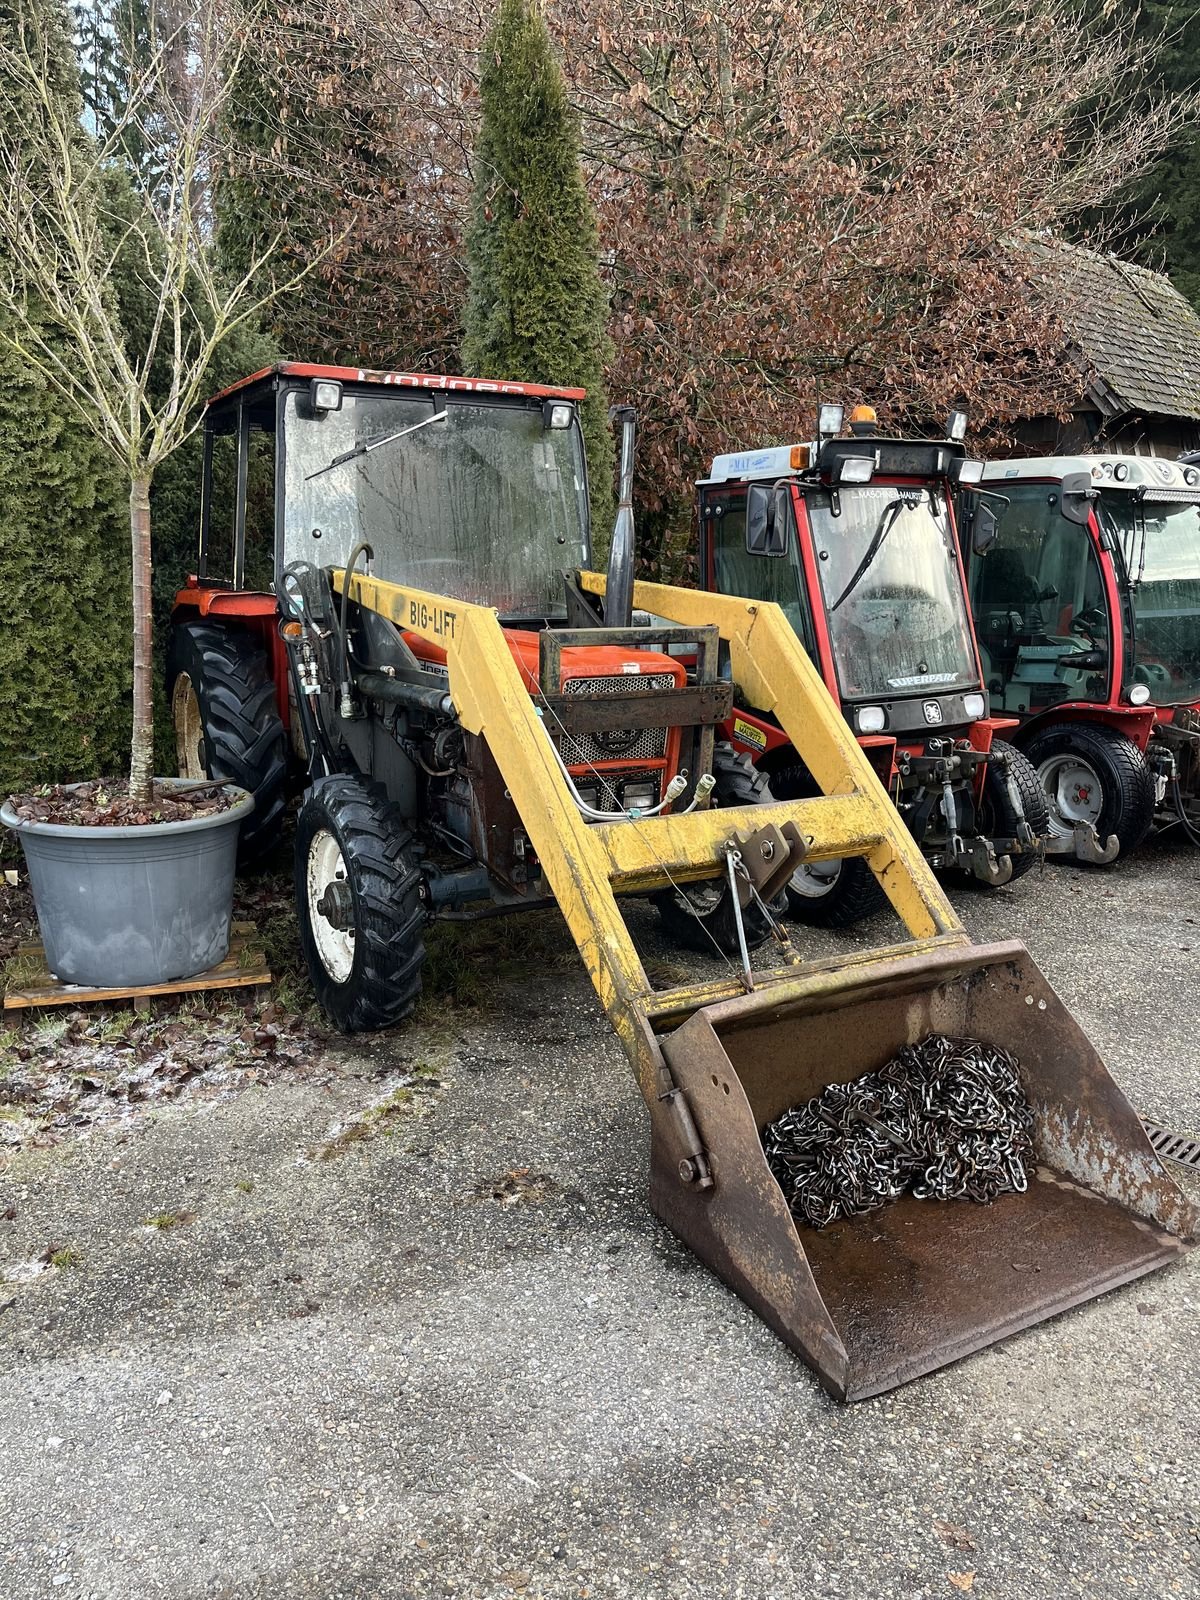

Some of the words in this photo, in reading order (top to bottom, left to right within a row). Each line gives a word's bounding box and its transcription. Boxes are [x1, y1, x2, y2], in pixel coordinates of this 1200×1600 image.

[410, 601, 456, 639] BIG-LIFT
[420, 661, 448, 676] dner
[887, 672, 959, 688] SUPERPARK
